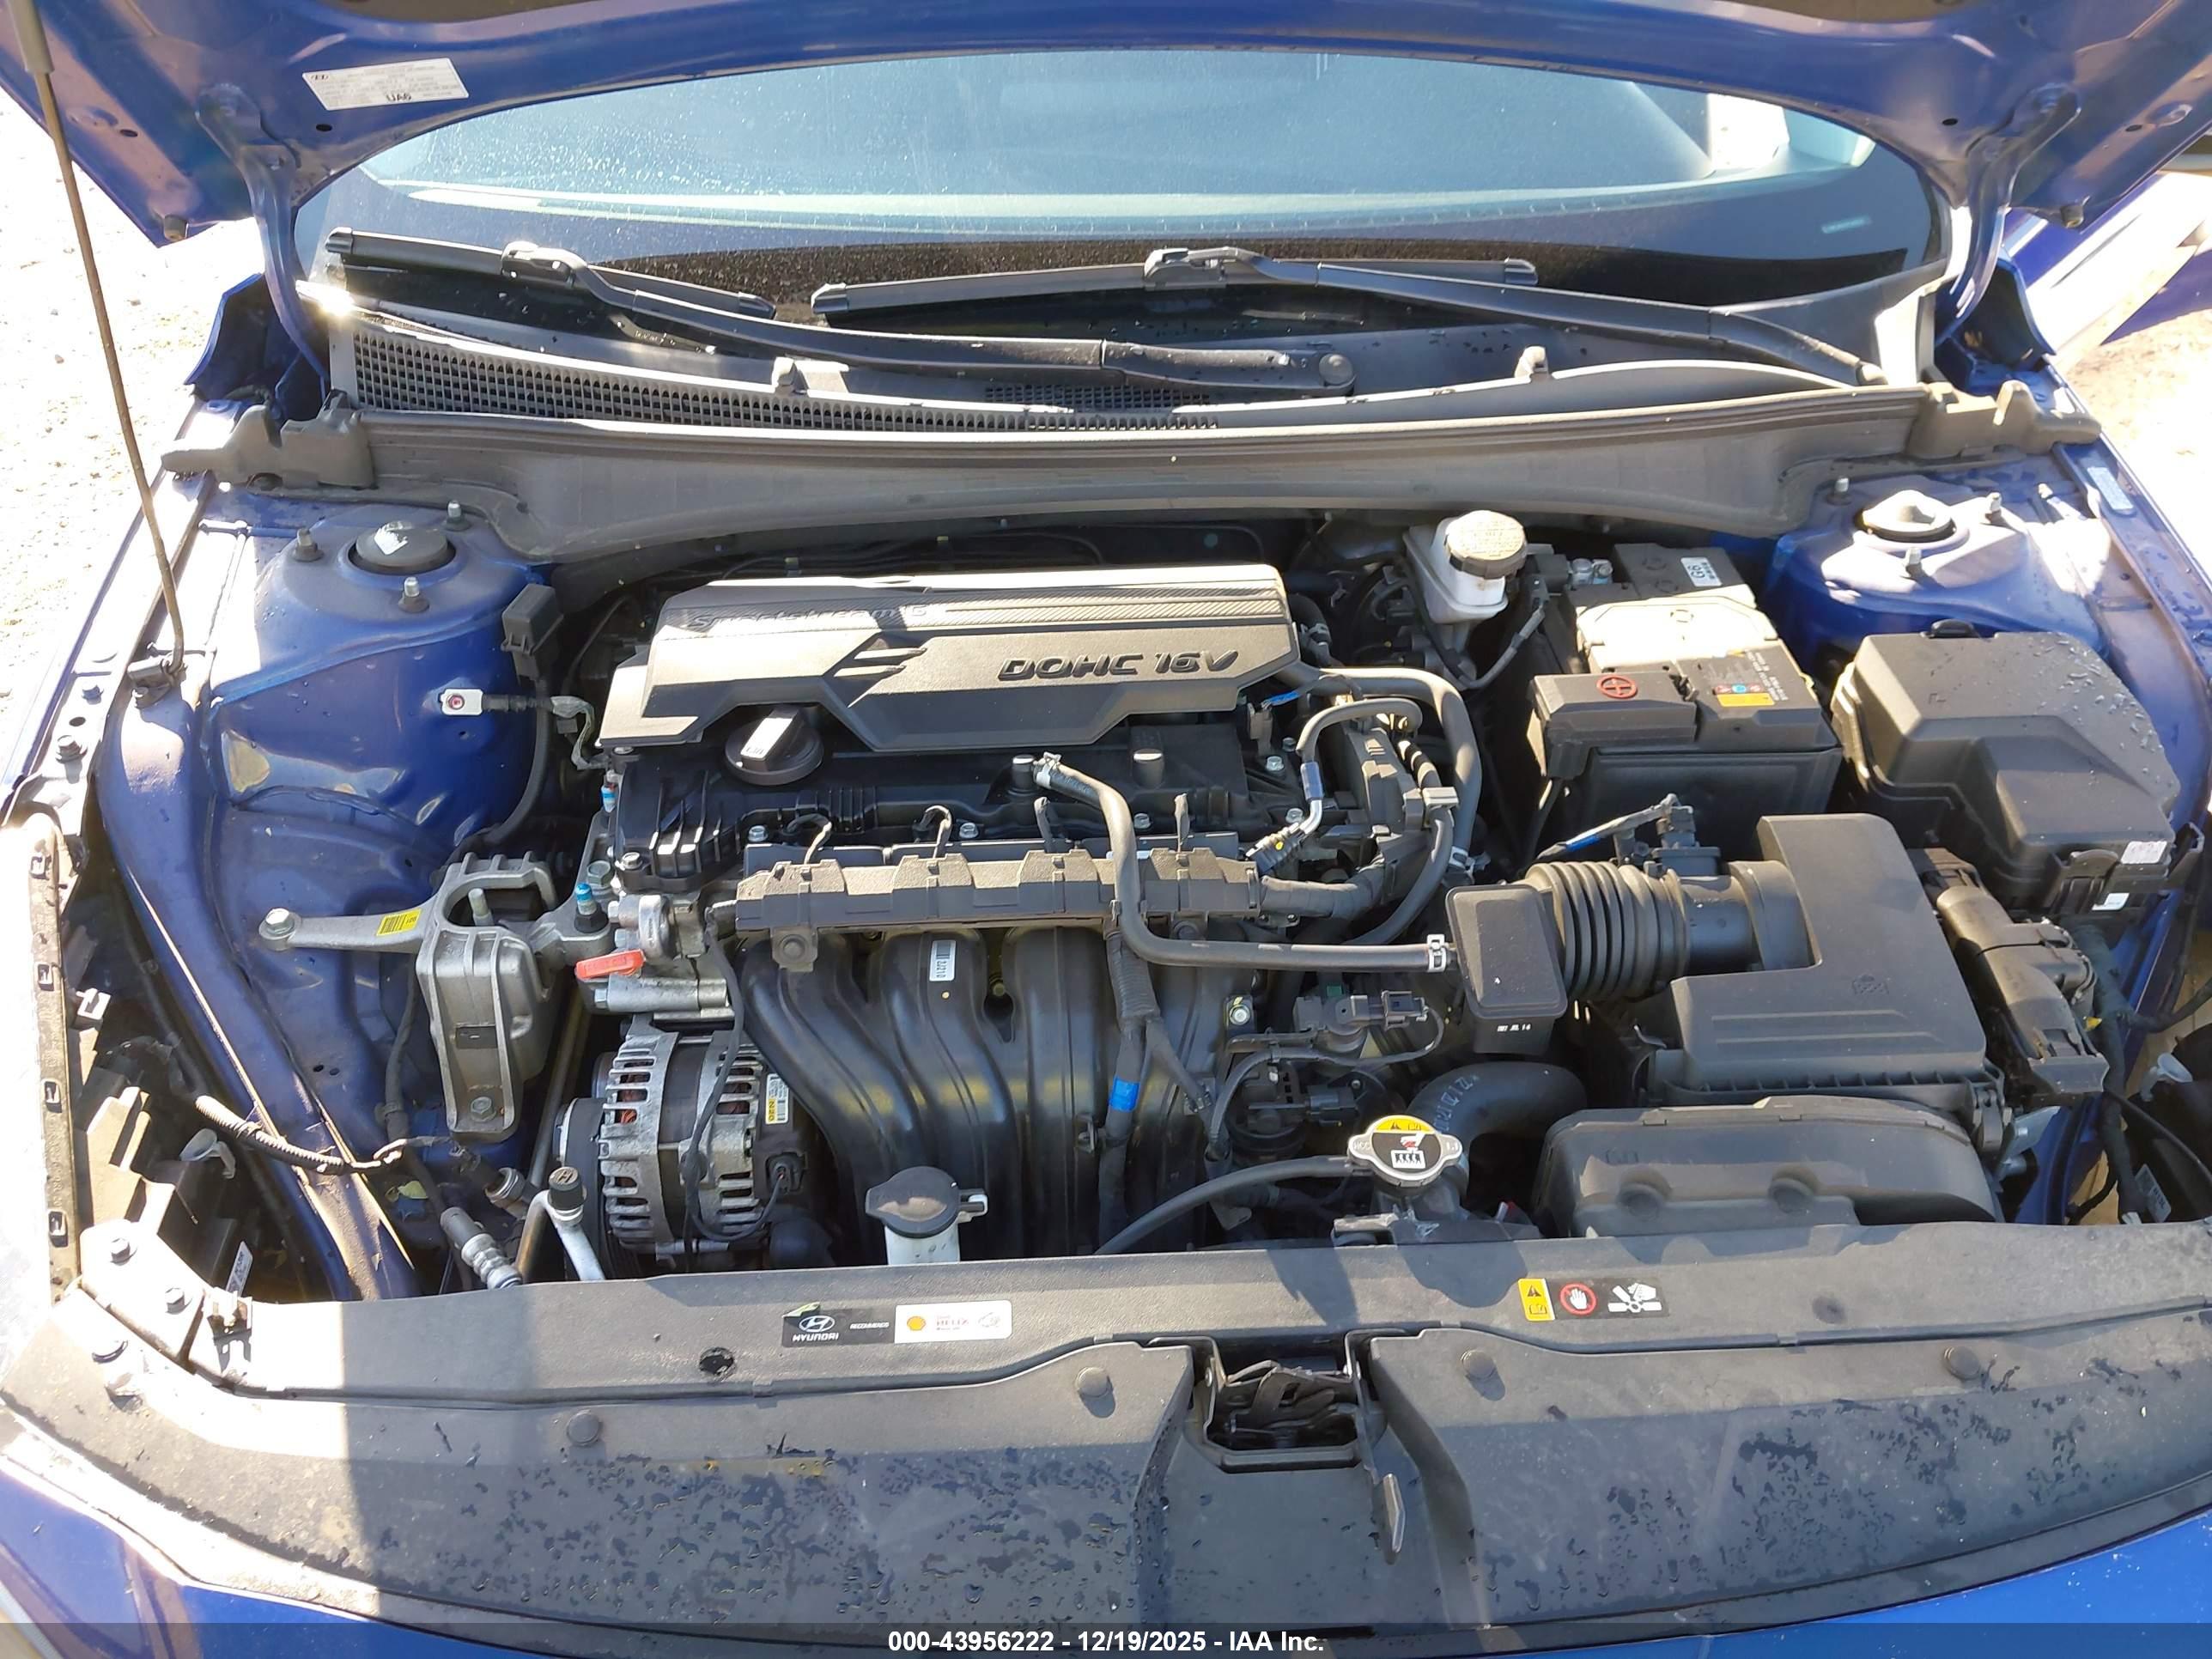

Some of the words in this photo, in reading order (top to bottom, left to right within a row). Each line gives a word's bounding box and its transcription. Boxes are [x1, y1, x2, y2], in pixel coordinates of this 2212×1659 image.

[997, 653, 1145, 681] DOHC
[1154, 651, 1239, 673] 16V
[792, 1332, 840, 1342] HYUNDAI
